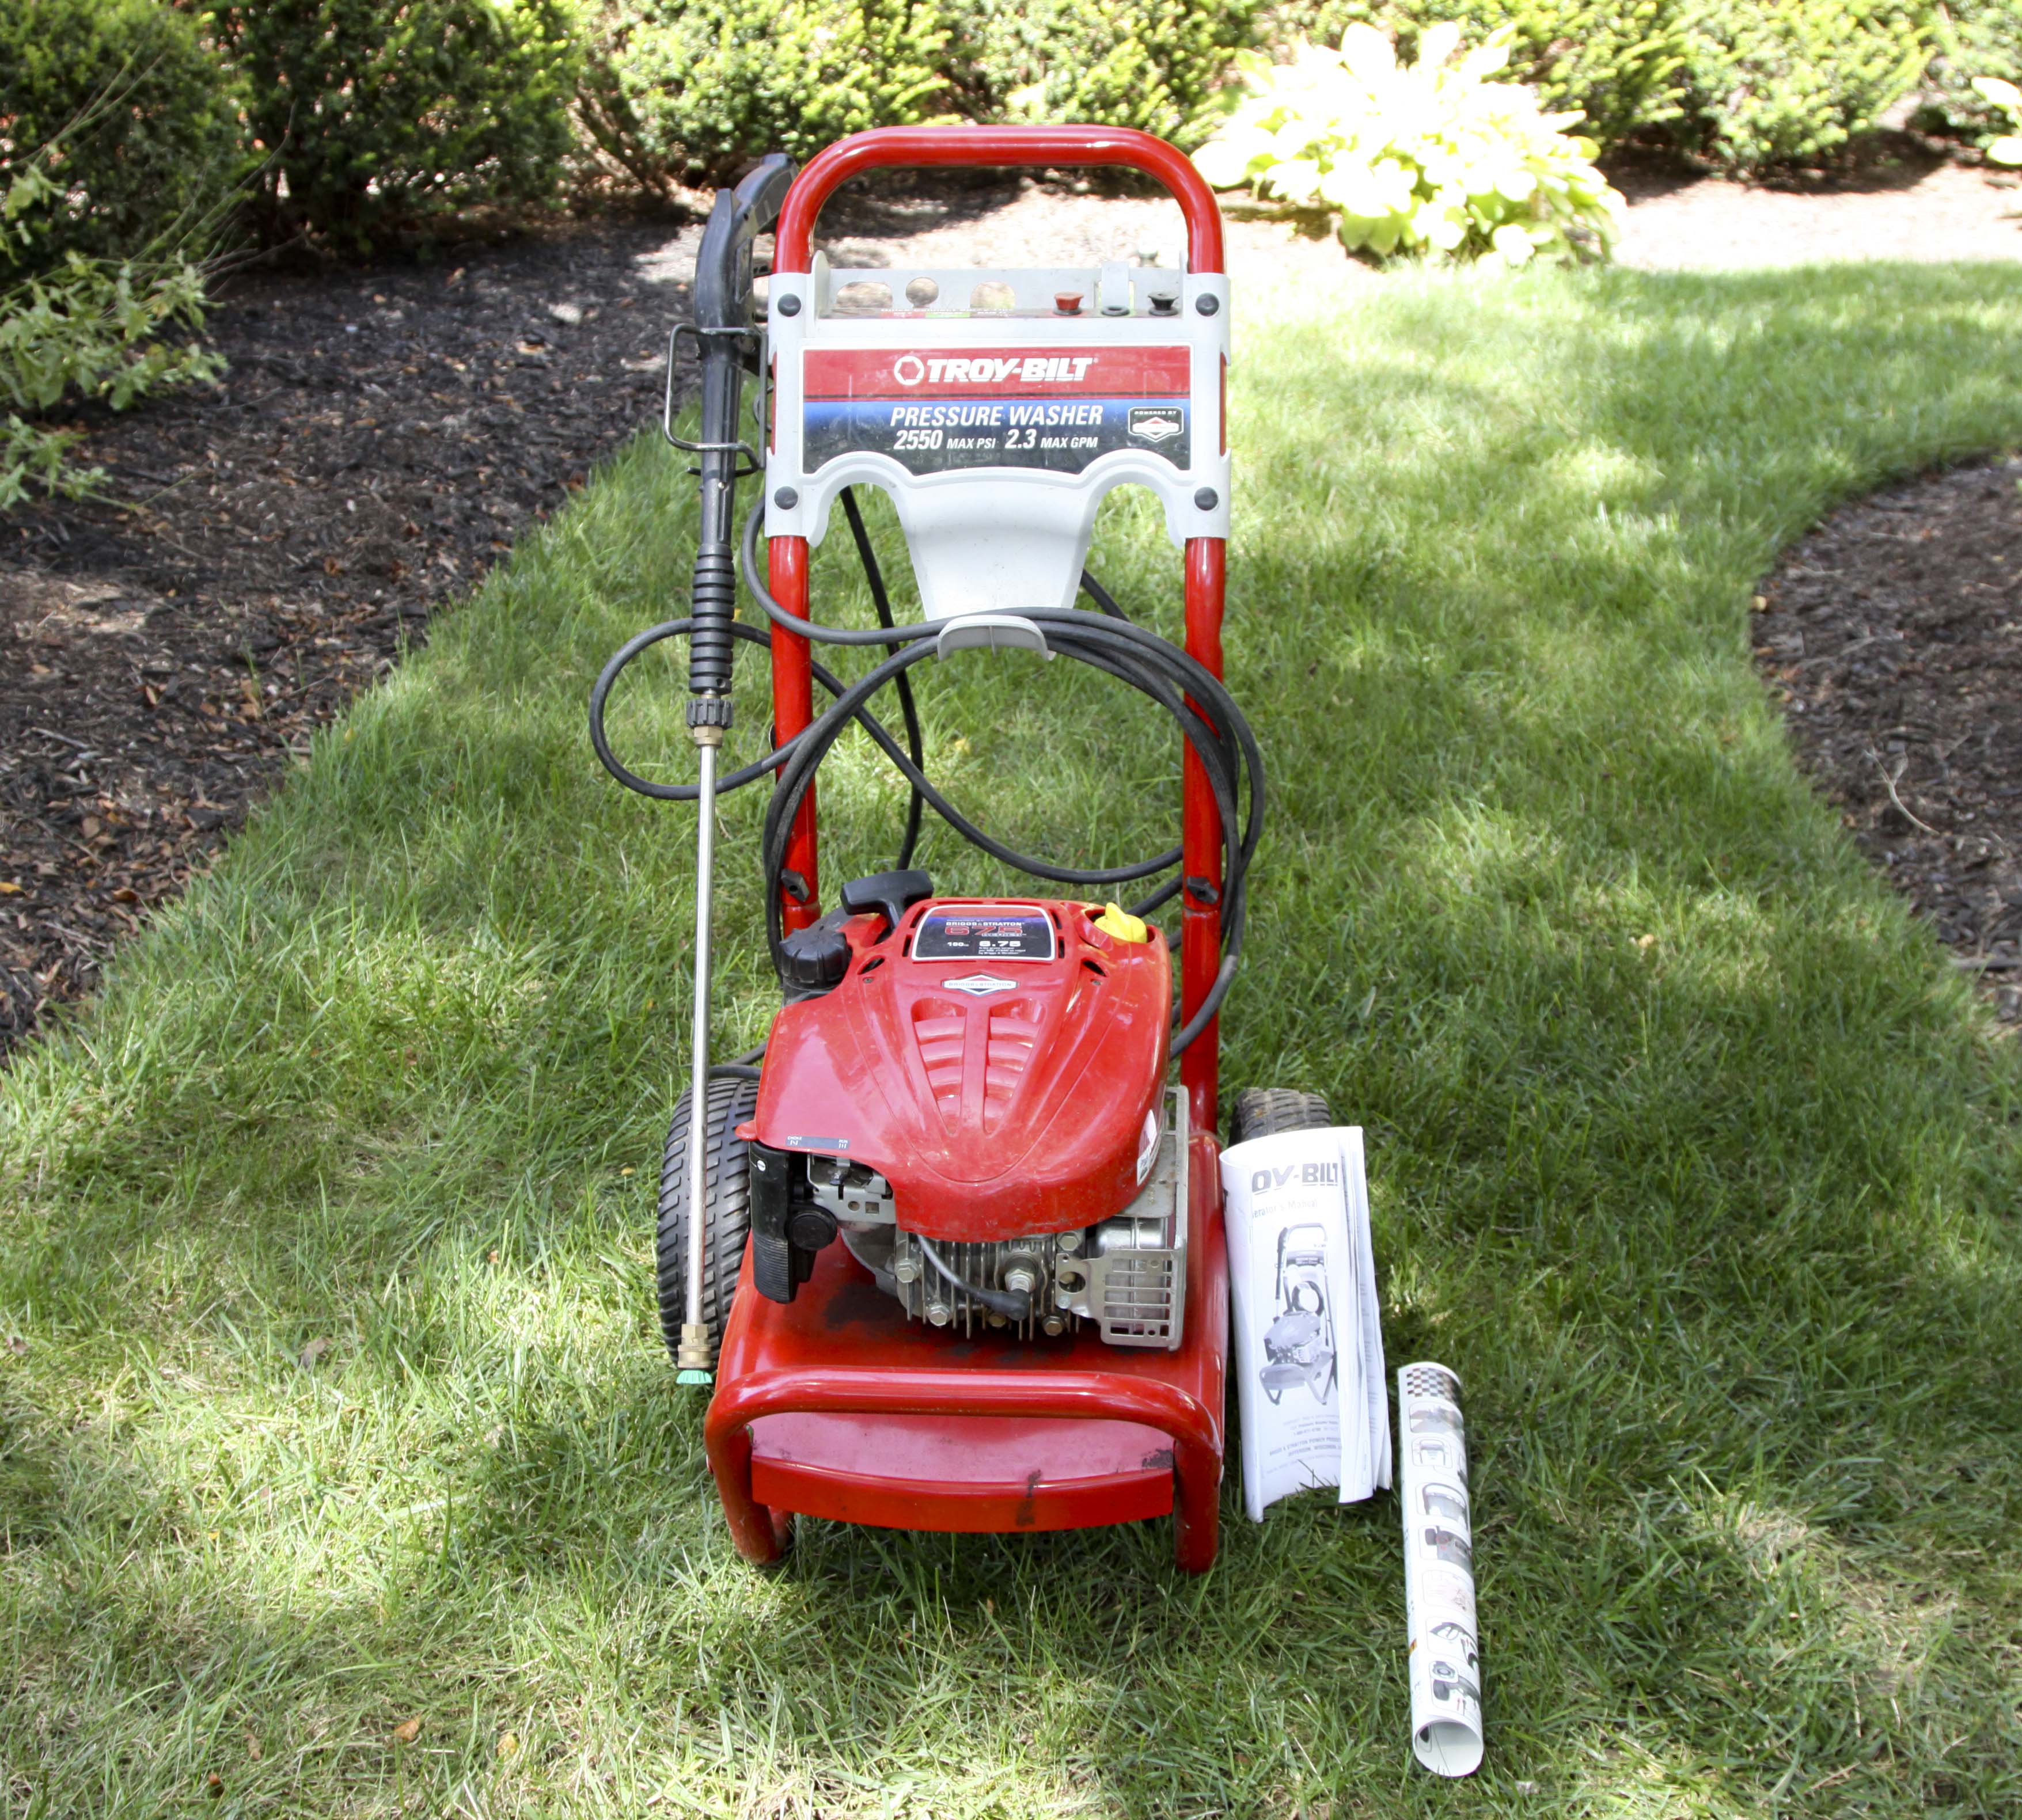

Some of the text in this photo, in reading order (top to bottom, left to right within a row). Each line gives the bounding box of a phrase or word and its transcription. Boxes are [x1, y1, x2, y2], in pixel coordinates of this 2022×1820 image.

[927, 357, 1094, 382] TROY-BILT
[890, 405, 1104, 427] PRESSURE WASHER
[893, 428, 1099, 450] 2550 MAX PSI 2.3 MAX GPM
[944, 926, 1023, 936] 675
[1251, 1162, 1338, 1194] OY-BILT
